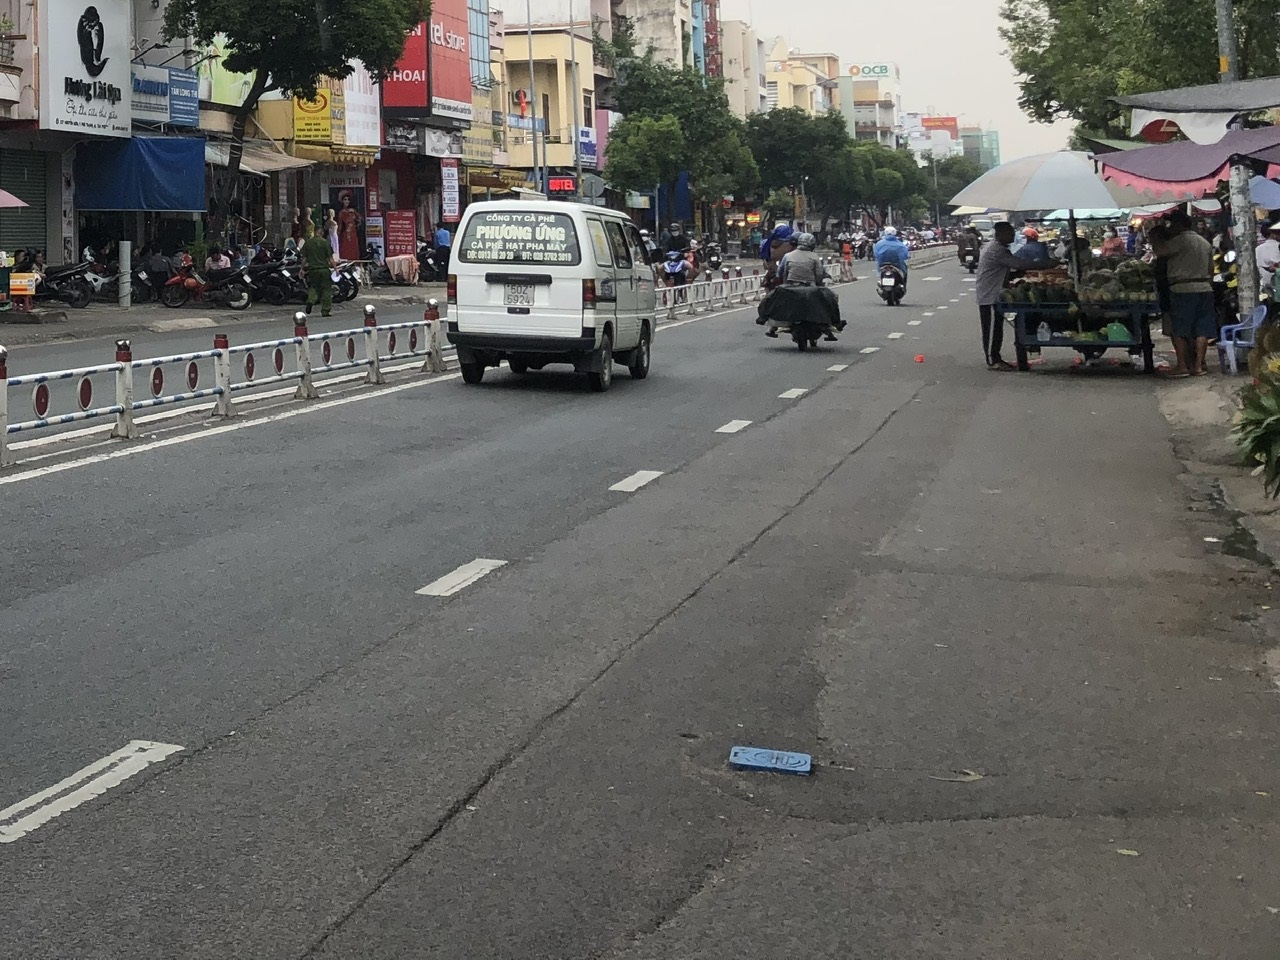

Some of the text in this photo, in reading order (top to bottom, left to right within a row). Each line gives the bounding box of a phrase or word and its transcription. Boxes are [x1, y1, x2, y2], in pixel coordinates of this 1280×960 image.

[445, 29, 466, 53] store
[861, 65, 889, 75] OCB
[486, 213, 510, 222] CÔNG
[524, 213, 537, 222] CÀ
[537, 214, 556, 223] PHÊ
[476, 223, 566, 241] PHƯƠNG ỨNG
[470, 240, 567, 252] CÀ PHÊ HẠT PHA MÁY
[506, 294, 531, 304] 5924
